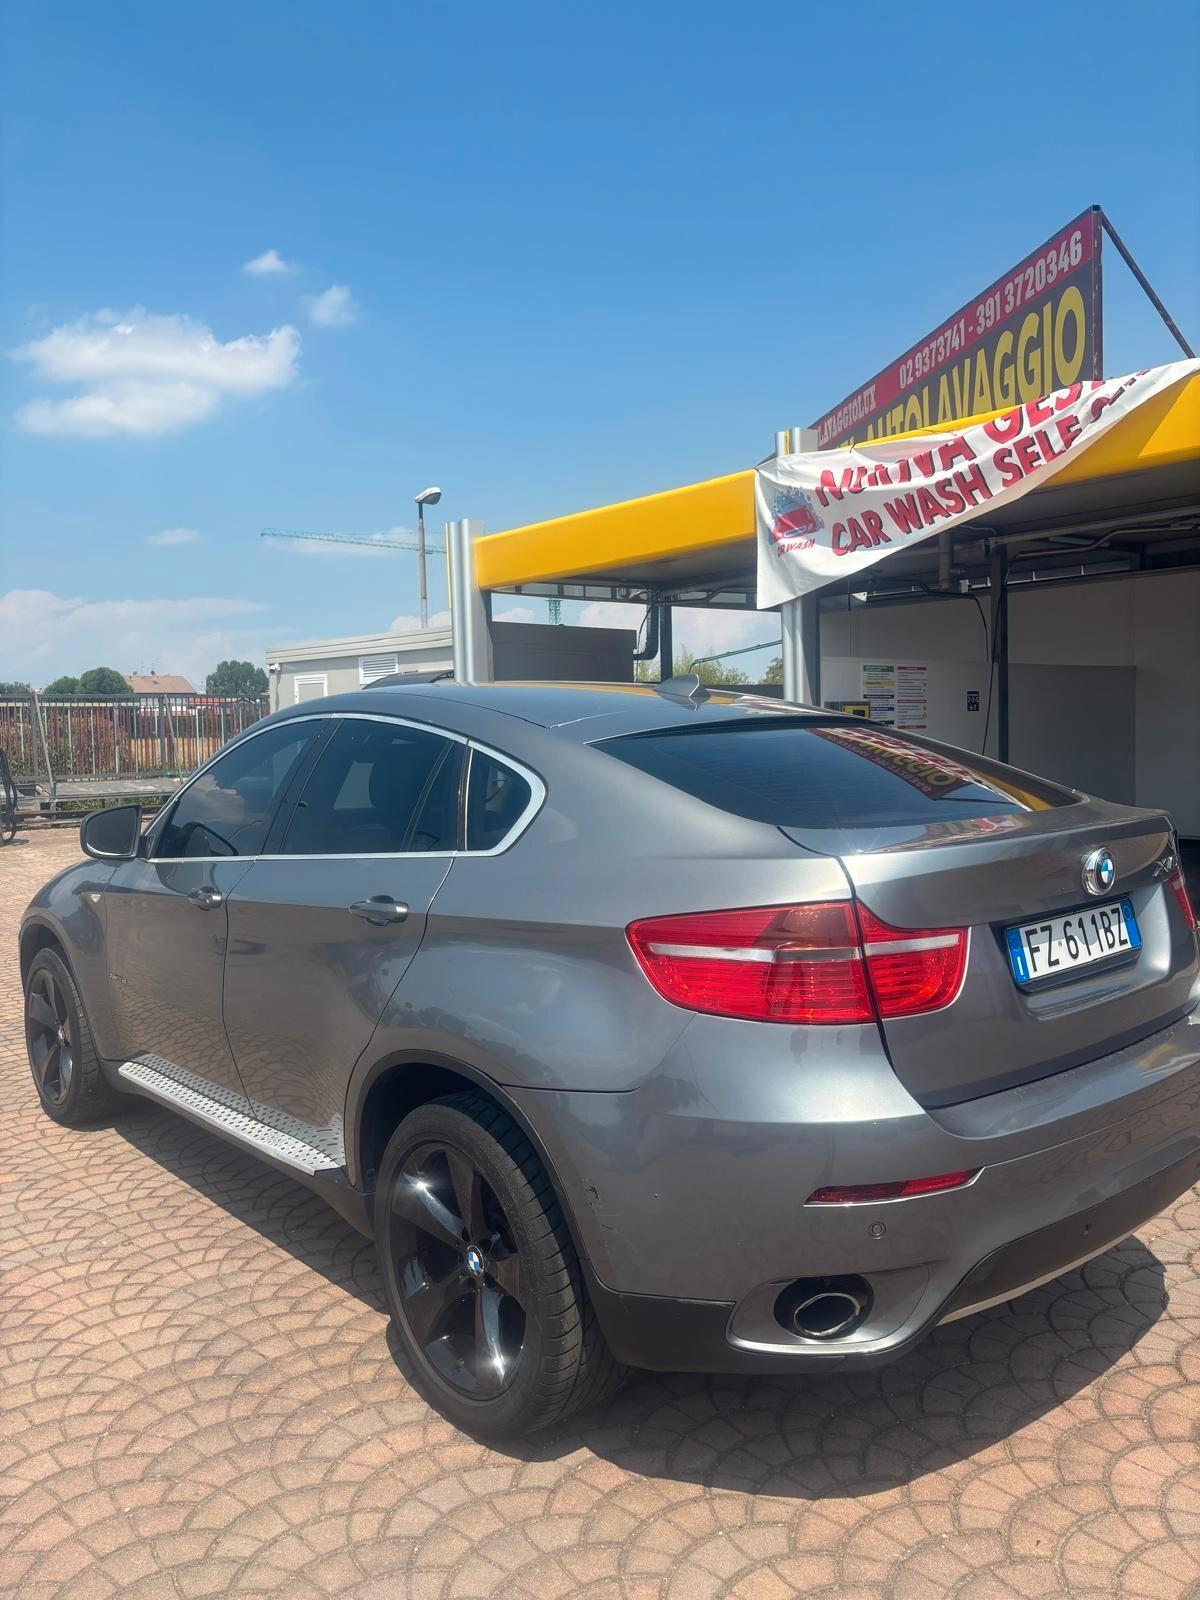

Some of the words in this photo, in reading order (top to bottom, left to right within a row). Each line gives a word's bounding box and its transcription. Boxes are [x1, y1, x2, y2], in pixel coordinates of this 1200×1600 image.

[866, 285, 1086, 442] TOLAVAGGIO
[899, 359, 914, 389] 02
[915, 318, 965, 378] 9373741
[976, 291, 1001, 335] 391
[1004, 230, 1082, 314] 3720346
[832, 509, 892, 557] CAR
[883, 462, 994, 535] WASH
[1024, 924, 1060, 973] FZ
[1062, 907, 1128, 960] 611BZ
